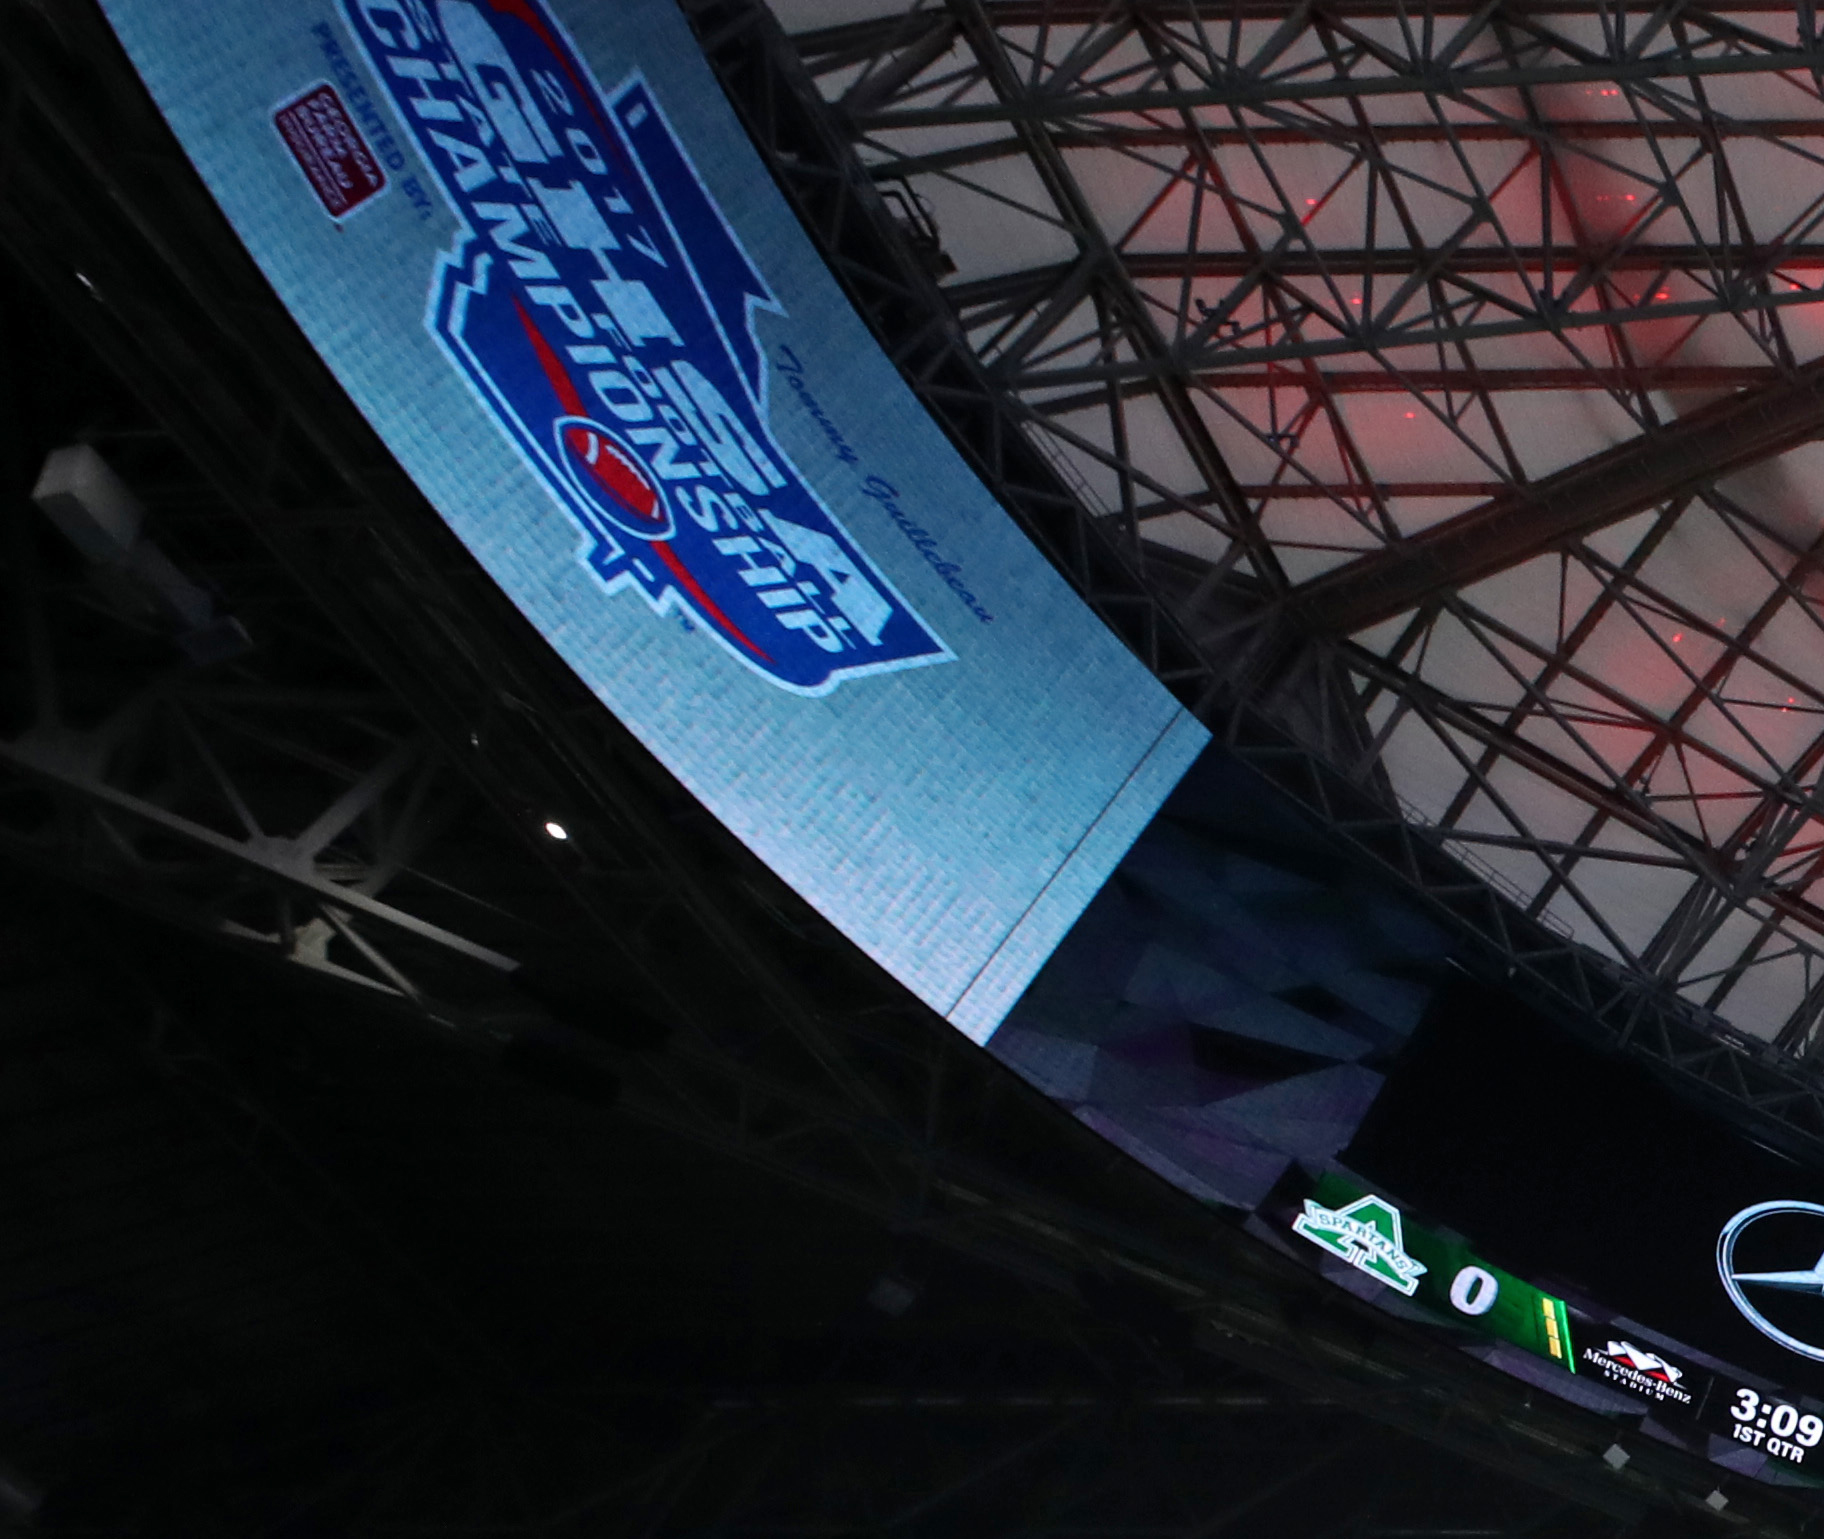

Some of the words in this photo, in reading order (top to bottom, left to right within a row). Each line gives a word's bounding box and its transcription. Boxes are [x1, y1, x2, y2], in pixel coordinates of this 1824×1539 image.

[310, 21, 406, 172] PRESENTED
[530, 68, 667, 267] 2017
[357, 0, 845, 653] CHAMPIONSHIP
[435, 0, 893, 646] GHSA
[592, 314, 858, 650] FOOTBALL
[1317, 1210, 1410, 1272] SPARTANS
[1449, 1265, 1499, 1317] 0
[1582, 1347, 1693, 1405] Mercedes-Benz
[1602, 1370, 1667, 1402] STADIUM
[1729, 1387, 1824, 1448] 3:09
[1731, 1422, 1766, 1449] 1ST
[1766, 1435, 1806, 1463] QTR
